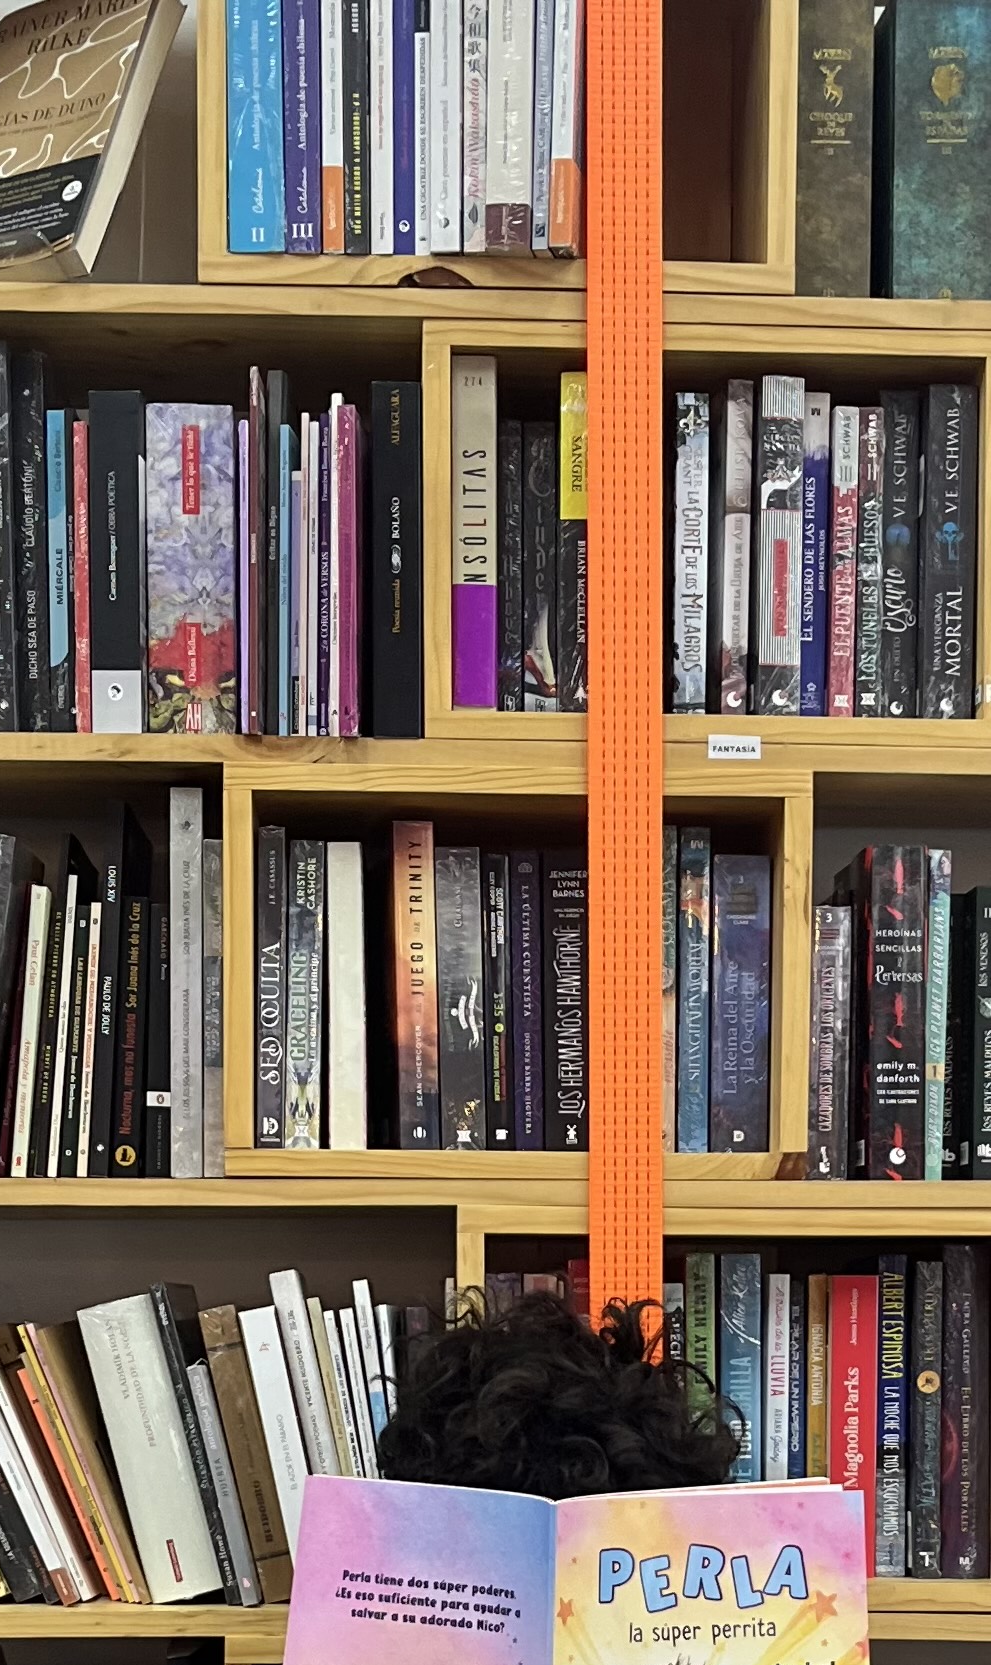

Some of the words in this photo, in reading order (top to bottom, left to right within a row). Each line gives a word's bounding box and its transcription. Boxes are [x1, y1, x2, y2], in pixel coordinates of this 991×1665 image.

[27, 26, 90, 56] RILKE
[32, 106, 55, 121] DE
[59, 92, 107, 116] DUINO
[292, 223, 313, 238] III
[392, 388, 400, 445] ALFAGUARA
[867, 413, 878, 458] SCHWAB
[945, 407, 961, 483] SCHWAB
[572, 435, 583, 493] SANGRE
[687, 492, 697, 505] LA
[805, 476, 816, 521] FLORES
[391, 496, 401, 539] BOLAÑO
[460, 449, 487, 583] NSÓLITAS
[681, 508, 702, 555] CORTE
[804, 523, 815, 546] LAS
[578, 540, 586, 575] BRIAN
[688, 556, 698, 569] DE
[803, 550, 814, 567] DE
[55, 548, 64, 605] MIÉRCALE
[686, 573, 697, 589] LOS
[26, 590, 36, 614] PASO
[802, 570, 814, 620] SENDERO
[28, 617, 37, 629] DE
[681, 593, 702, 673] MILAGROS
[800, 622, 814, 641] EL
[945, 586, 964, 677] MORTAL
[28, 631, 37, 648] SEA
[28, 651, 38, 678] DICHO
[106, 865, 117, 888] LOUIS
[296, 862, 306, 904] KRISTIN
[308, 858, 316, 909] CASHORE
[408, 840, 423, 914] TRINITY
[549, 870, 588, 880] JENNIFER
[557, 880, 579, 888] LYNN
[105, 889, 116, 903] XIV
[553, 889, 585, 897] BARNES
[129, 902, 142, 921] Cruz
[128, 933, 140, 943] de
[129, 923, 141, 932] la
[875, 929, 922, 938] HEROÍNAS
[126, 946, 140, 963] Inés
[875, 944, 922, 953] SENCILLAS
[410, 941, 424, 996] JUEGO
[553, 924, 581, 1004] HAWTHORNE
[101, 976, 113, 1000] PAULO
[124, 966, 141, 992] Juana
[723, 962, 739, 1002] Aire
[101, 1002, 111, 1012] DE
[124, 994, 138, 1008] Sor
[100, 1014, 111, 1035] JOLLY
[723, 1005, 737, 1028] del
[415, 1025, 423, 1081] CHERCOVER
[557, 1006, 583, 1088] HERMANOS
[723, 1031, 737, 1075] Reina
[723, 1078, 737, 1095] La
[876, 1075, 920, 1083] danforth
[557, 1090, 586, 1119] LOS
[881, 1272, 905, 1318] ALBERT
[810, 1323, 825, 1362] IGNACIA
[881, 1319, 905, 1379] ESPINOSA
[769, 1354, 785, 1397] LLUVIA
[810, 1364, 825, 1406] ANTONIA
[843, 1366, 859, 1413] Parks
[883, 1386, 899, 1398] LA
[883, 1402, 900, 1430] NOCHE
[843, 1415, 863, 1488] Magnolia
[882, 1434, 899, 1450] QUE
[883, 1455, 900, 1474] NOS
[881, 1478, 900, 1537] ESCUCHAMOS
[342, 1569, 371, 1583] Perla
[375, 1573, 404, 1587] tiene
[408, 1576, 429, 1589] dos
[434, 1580, 468, 1594] súper
[472, 1584, 517, 1600] poderes.
[597, 1543, 809, 1613] PERLA
[336, 1586, 352, 1600] ¿Es
[355, 1591, 374, 1602] eso
[378, 1592, 437, 1608] suficiente
[441, 1599, 469, 1612] para
[474, 1603, 512, 1617] ayudar
[514, 1608, 520, 1618] a
[351, 1608, 387, 1620] salvar
[391, 1612, 398, 1621] a
[403, 1614, 416, 1623] su
[420, 1614, 473, 1629] adorado
[476, 1618, 505, 1633] Nico?
[628, 1622, 644, 1644] la
[652, 1621, 702, 1647] súper
[711, 1618, 776, 1646] perrita
